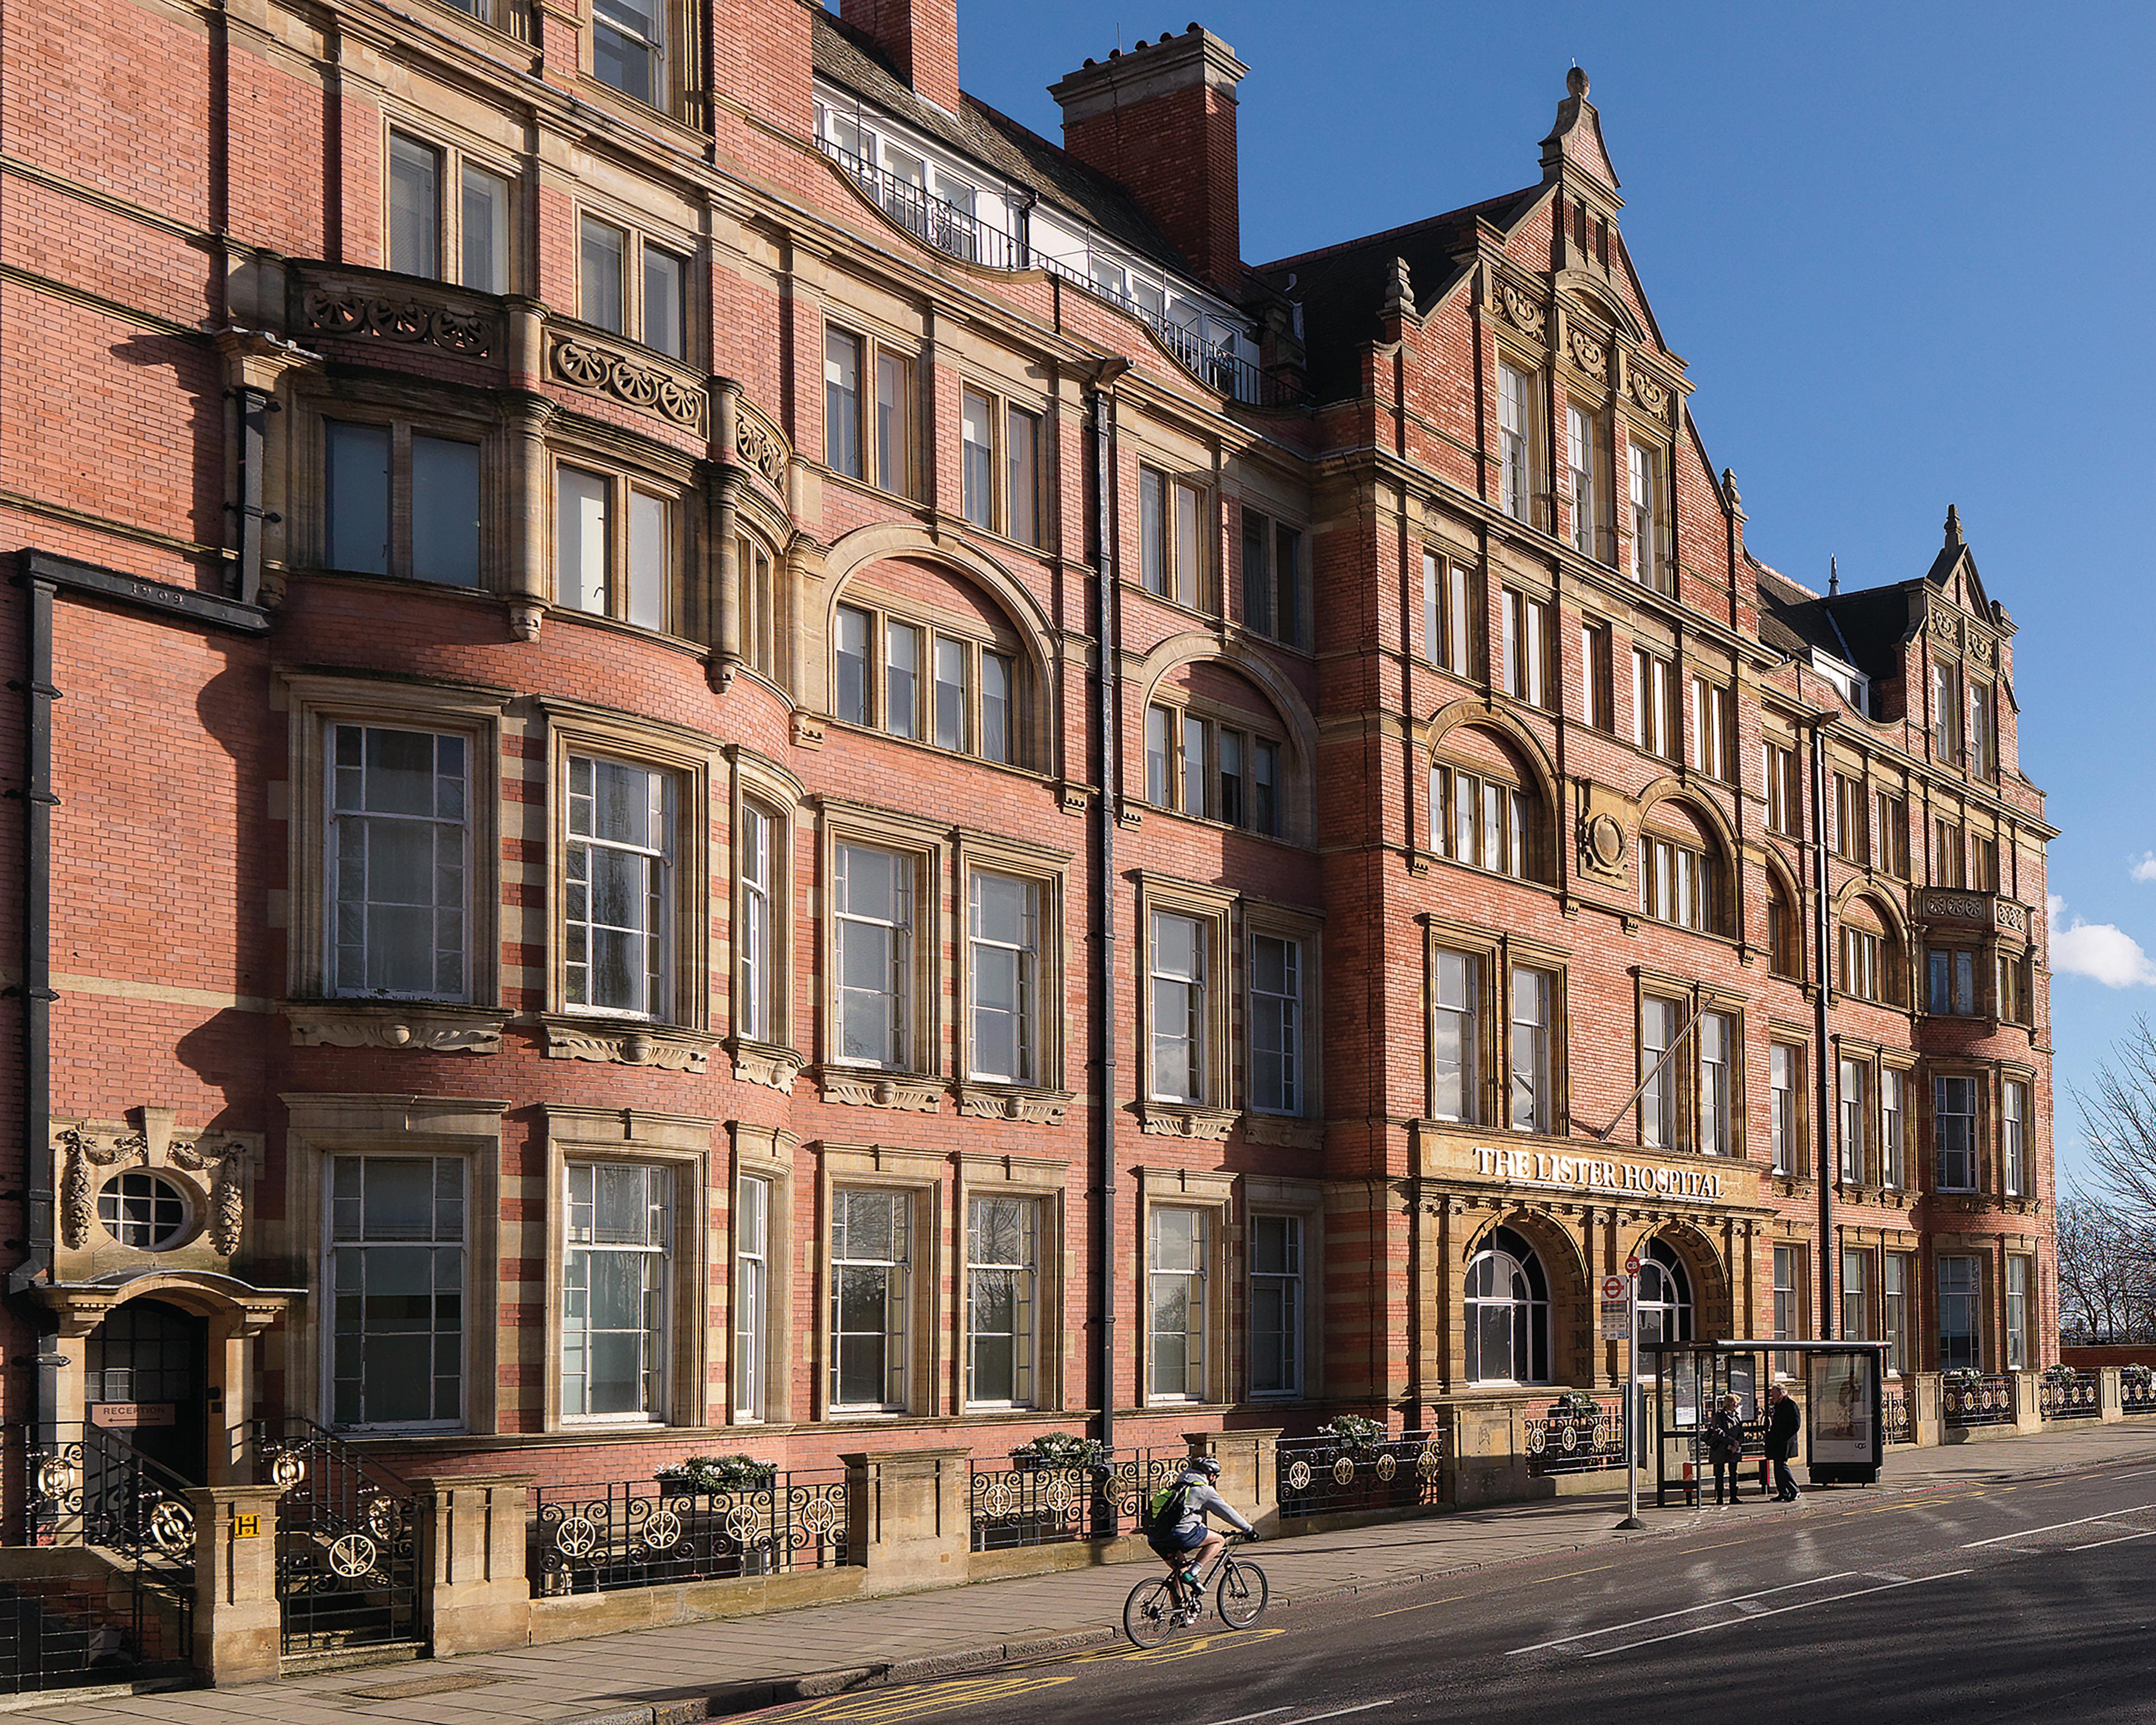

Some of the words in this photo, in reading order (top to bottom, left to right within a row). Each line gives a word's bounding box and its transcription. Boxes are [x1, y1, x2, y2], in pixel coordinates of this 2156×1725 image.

[131, 583, 182, 604] 1909
[1473, 1147, 1531, 1179] THE
[1533, 1153, 1616, 1187] LISTER
[1620, 1164, 1725, 1199] HOSPITAL
[103, 1406, 165, 1414] RECEPTION
